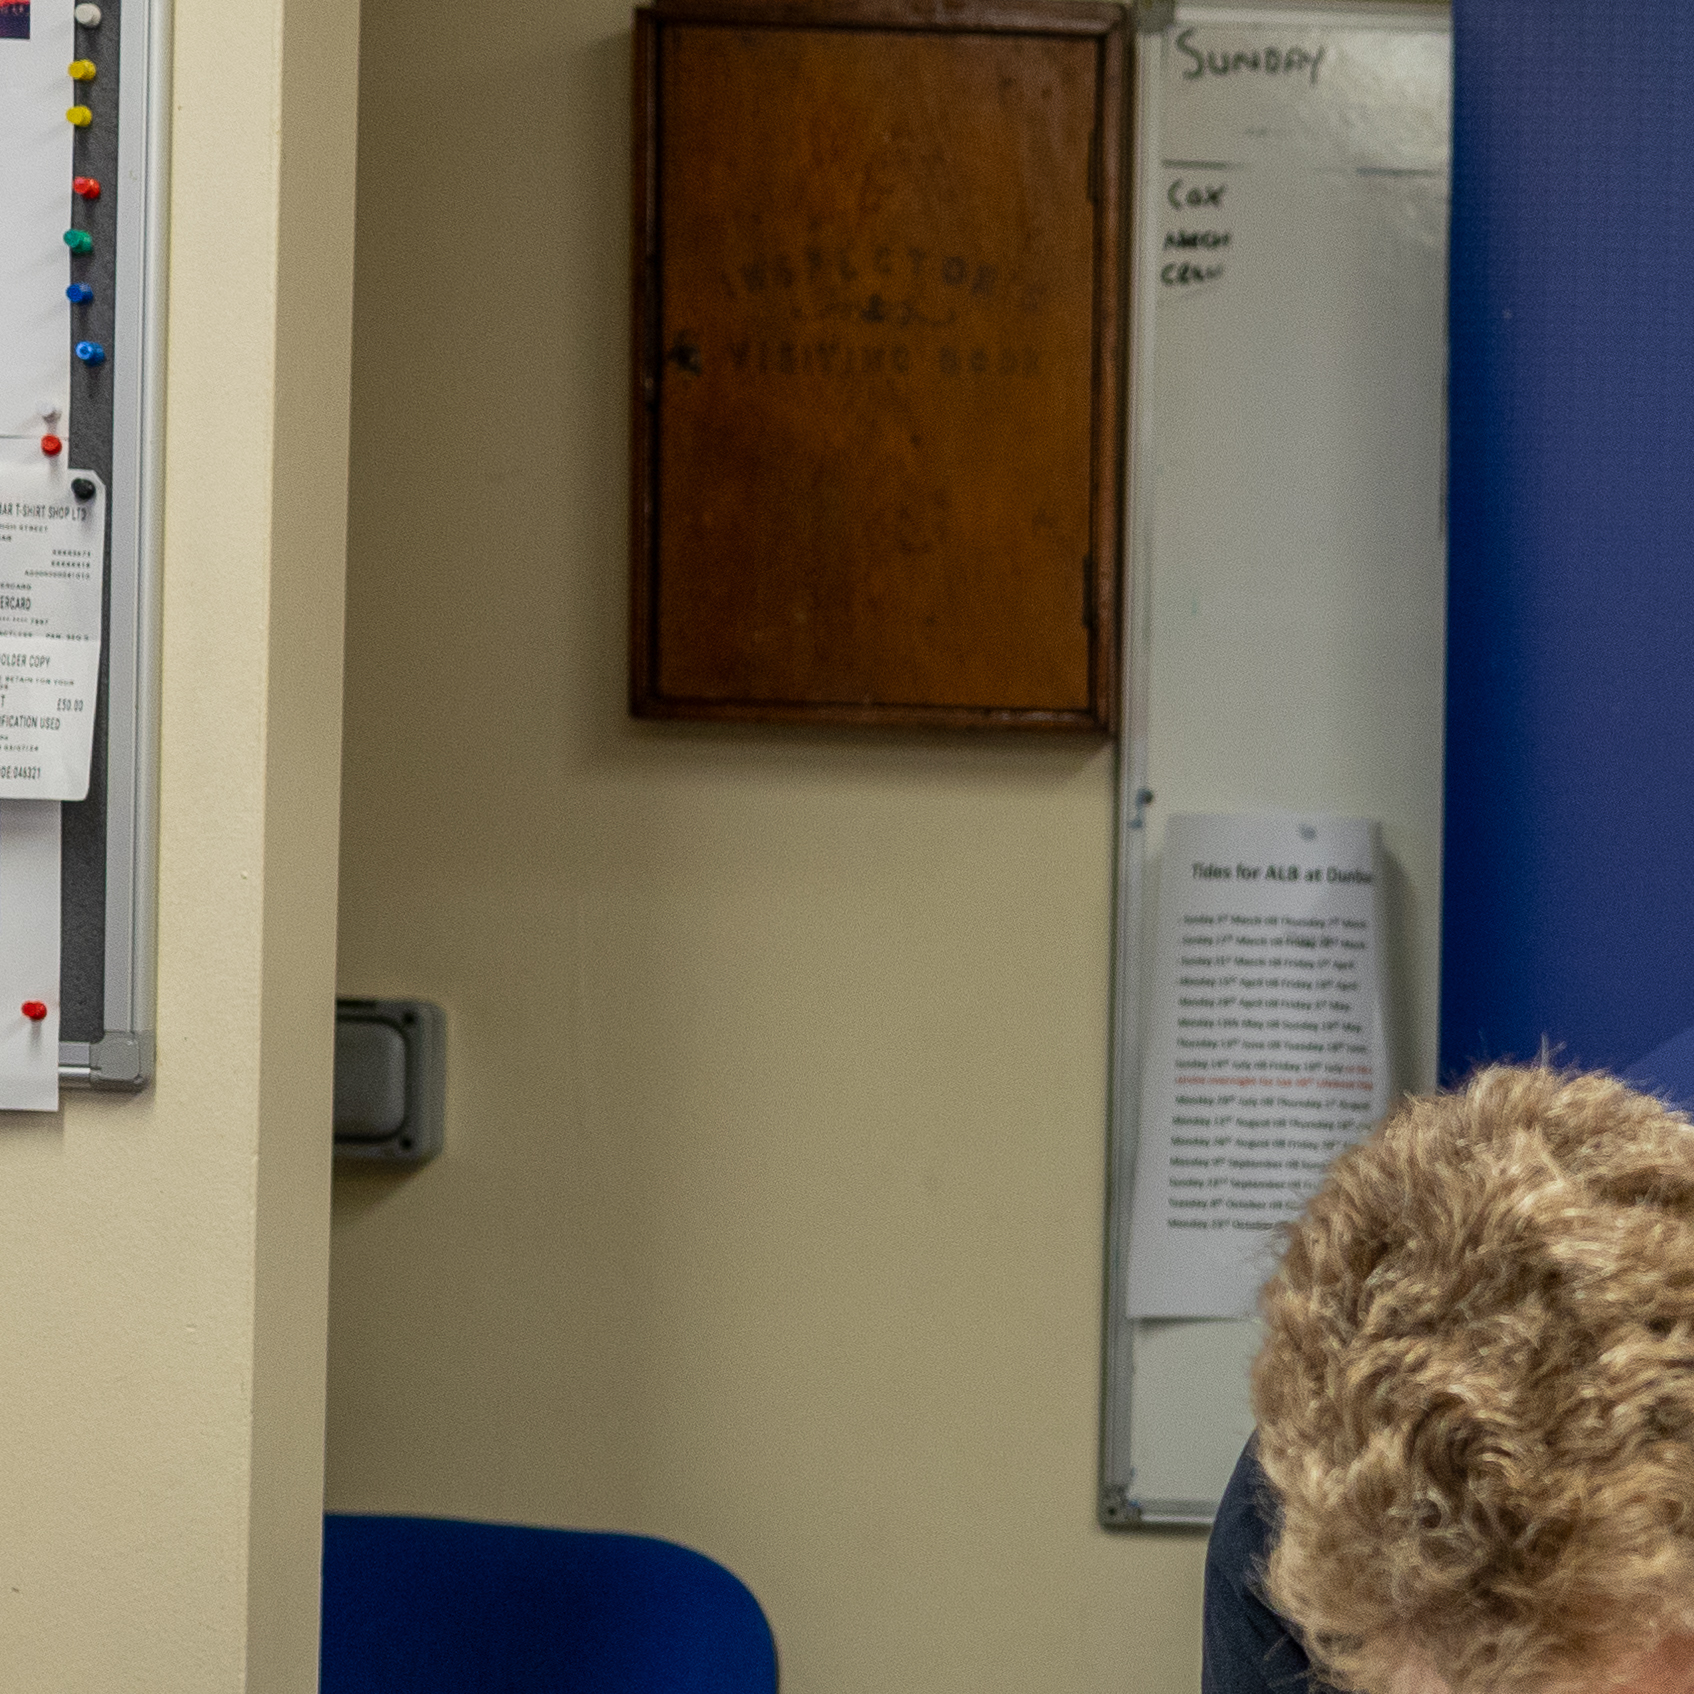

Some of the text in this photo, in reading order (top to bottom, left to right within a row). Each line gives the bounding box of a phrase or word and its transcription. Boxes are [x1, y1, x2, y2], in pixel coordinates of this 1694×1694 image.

[29, 655, 50, 668] COPY
[40, 717, 60, 731] USED
[1191, 861, 1232, 882] Tides
[1236, 863, 1260, 881] for
[1265, 864, 1299, 882] ALB
